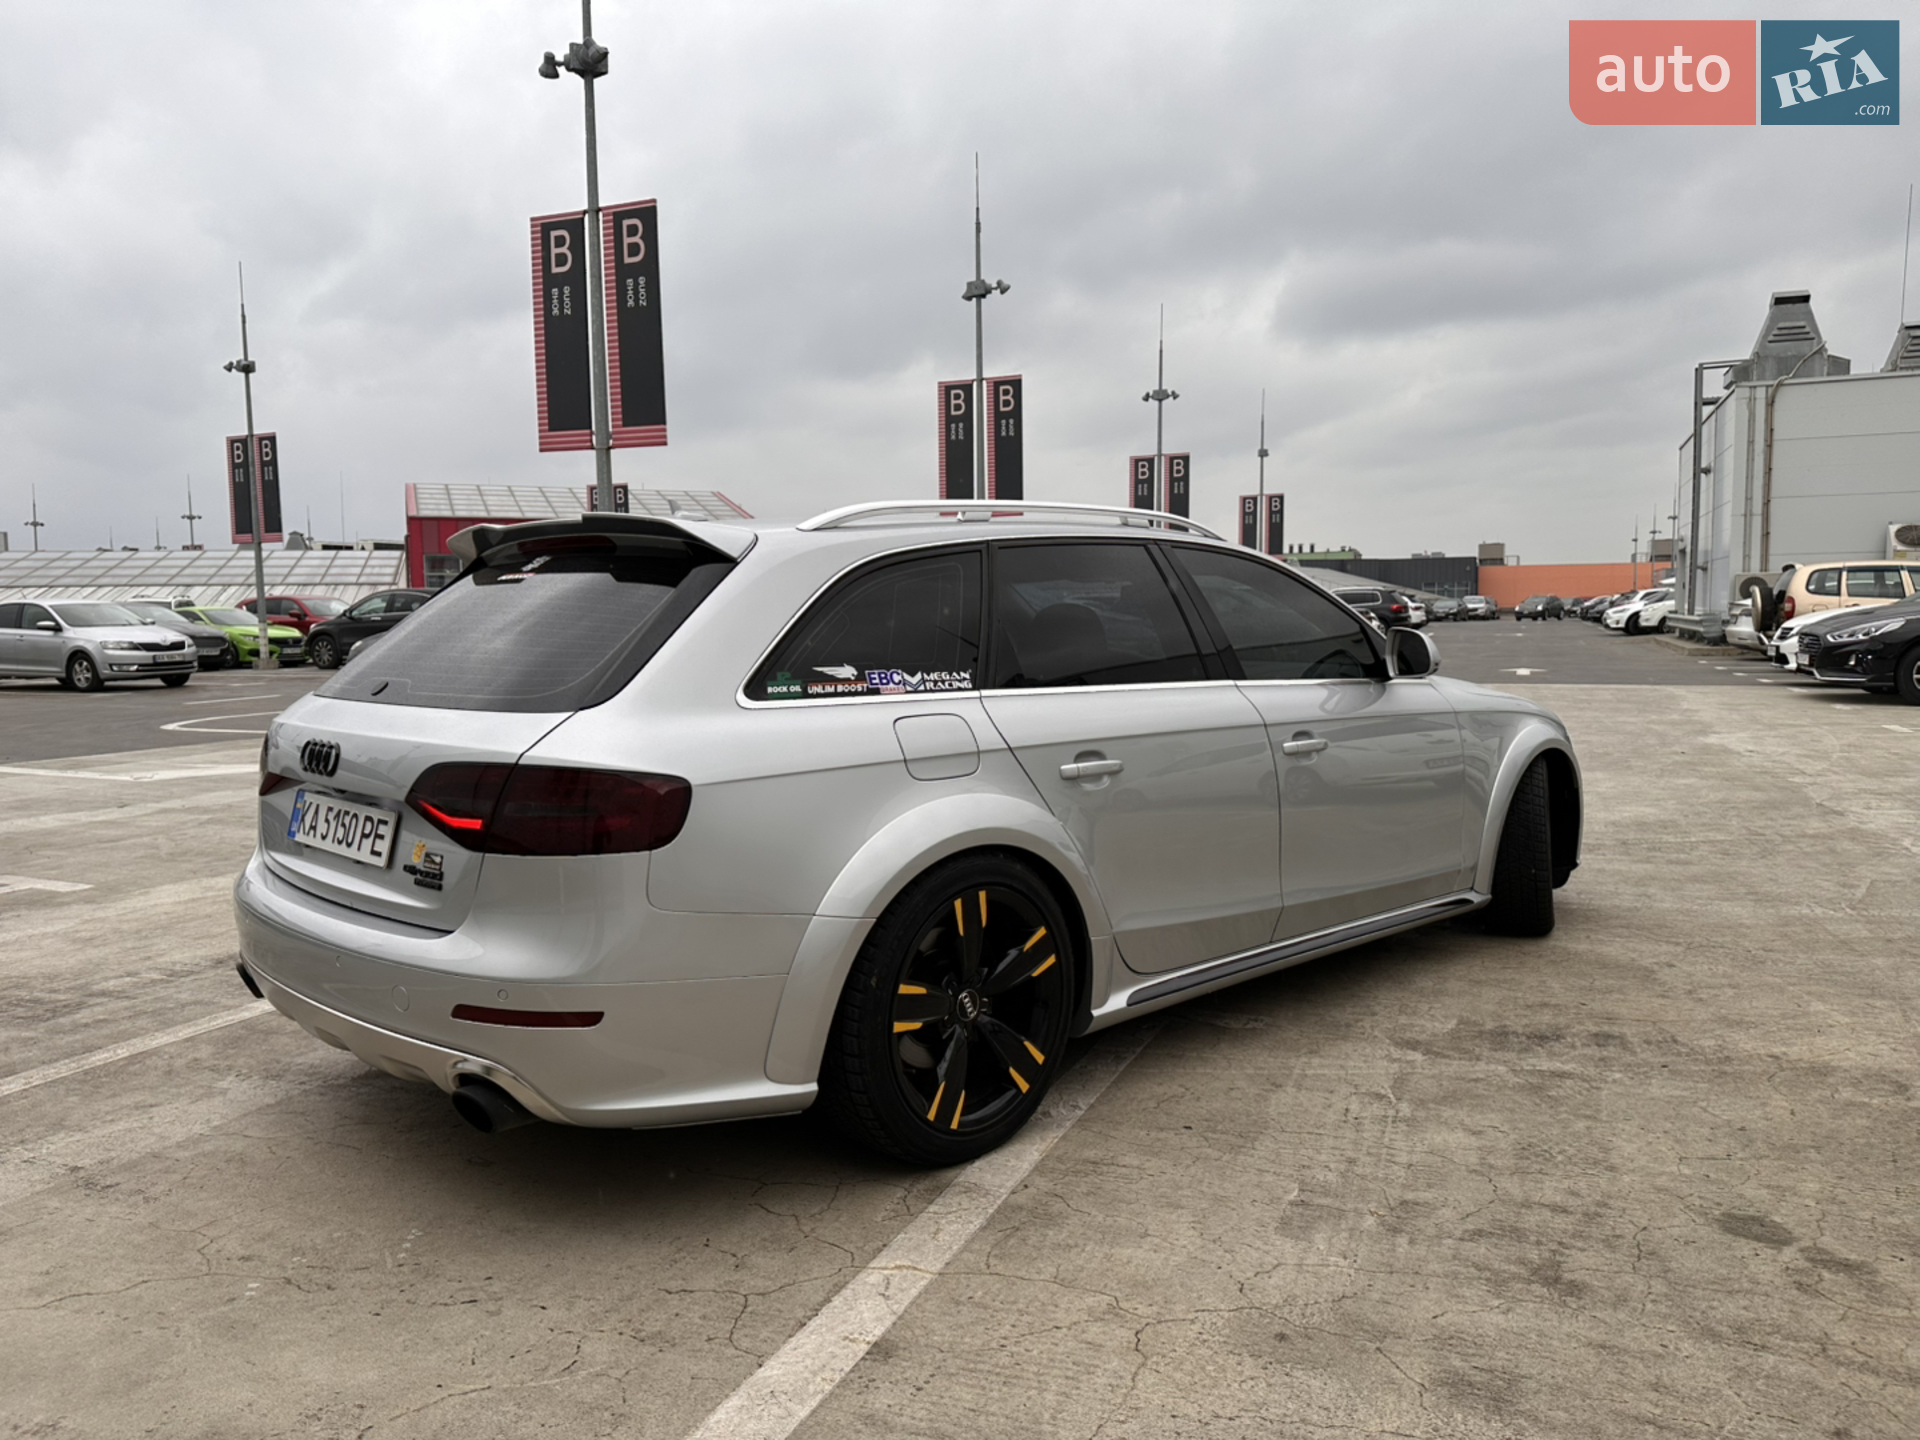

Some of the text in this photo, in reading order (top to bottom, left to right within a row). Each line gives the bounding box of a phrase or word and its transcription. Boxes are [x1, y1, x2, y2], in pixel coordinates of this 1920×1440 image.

[622, 218, 645, 264] B
[550, 229, 572, 274] B
[638, 276, 647, 307] zone
[563, 286, 572, 316] zone
[950, 389, 965, 415] B
[999, 385, 1014, 411] B
[233, 442, 244, 463] B
[261, 440, 272, 461] B
[1138, 461, 1149, 479] B
[1173, 459, 1184, 477] B
[616, 488, 625, 503] B
[1271, 497, 1281, 511] B
[1245, 499, 1254, 512] B
[867, 670, 902, 686] EBC
[923, 671, 971, 680] MEGAN
[768, 684, 802, 693] ROCK OIL
[837, 683, 867, 693] BOOST
[925, 680, 972, 690] RACING
[297, 800, 389, 858] KA 5150 PE
